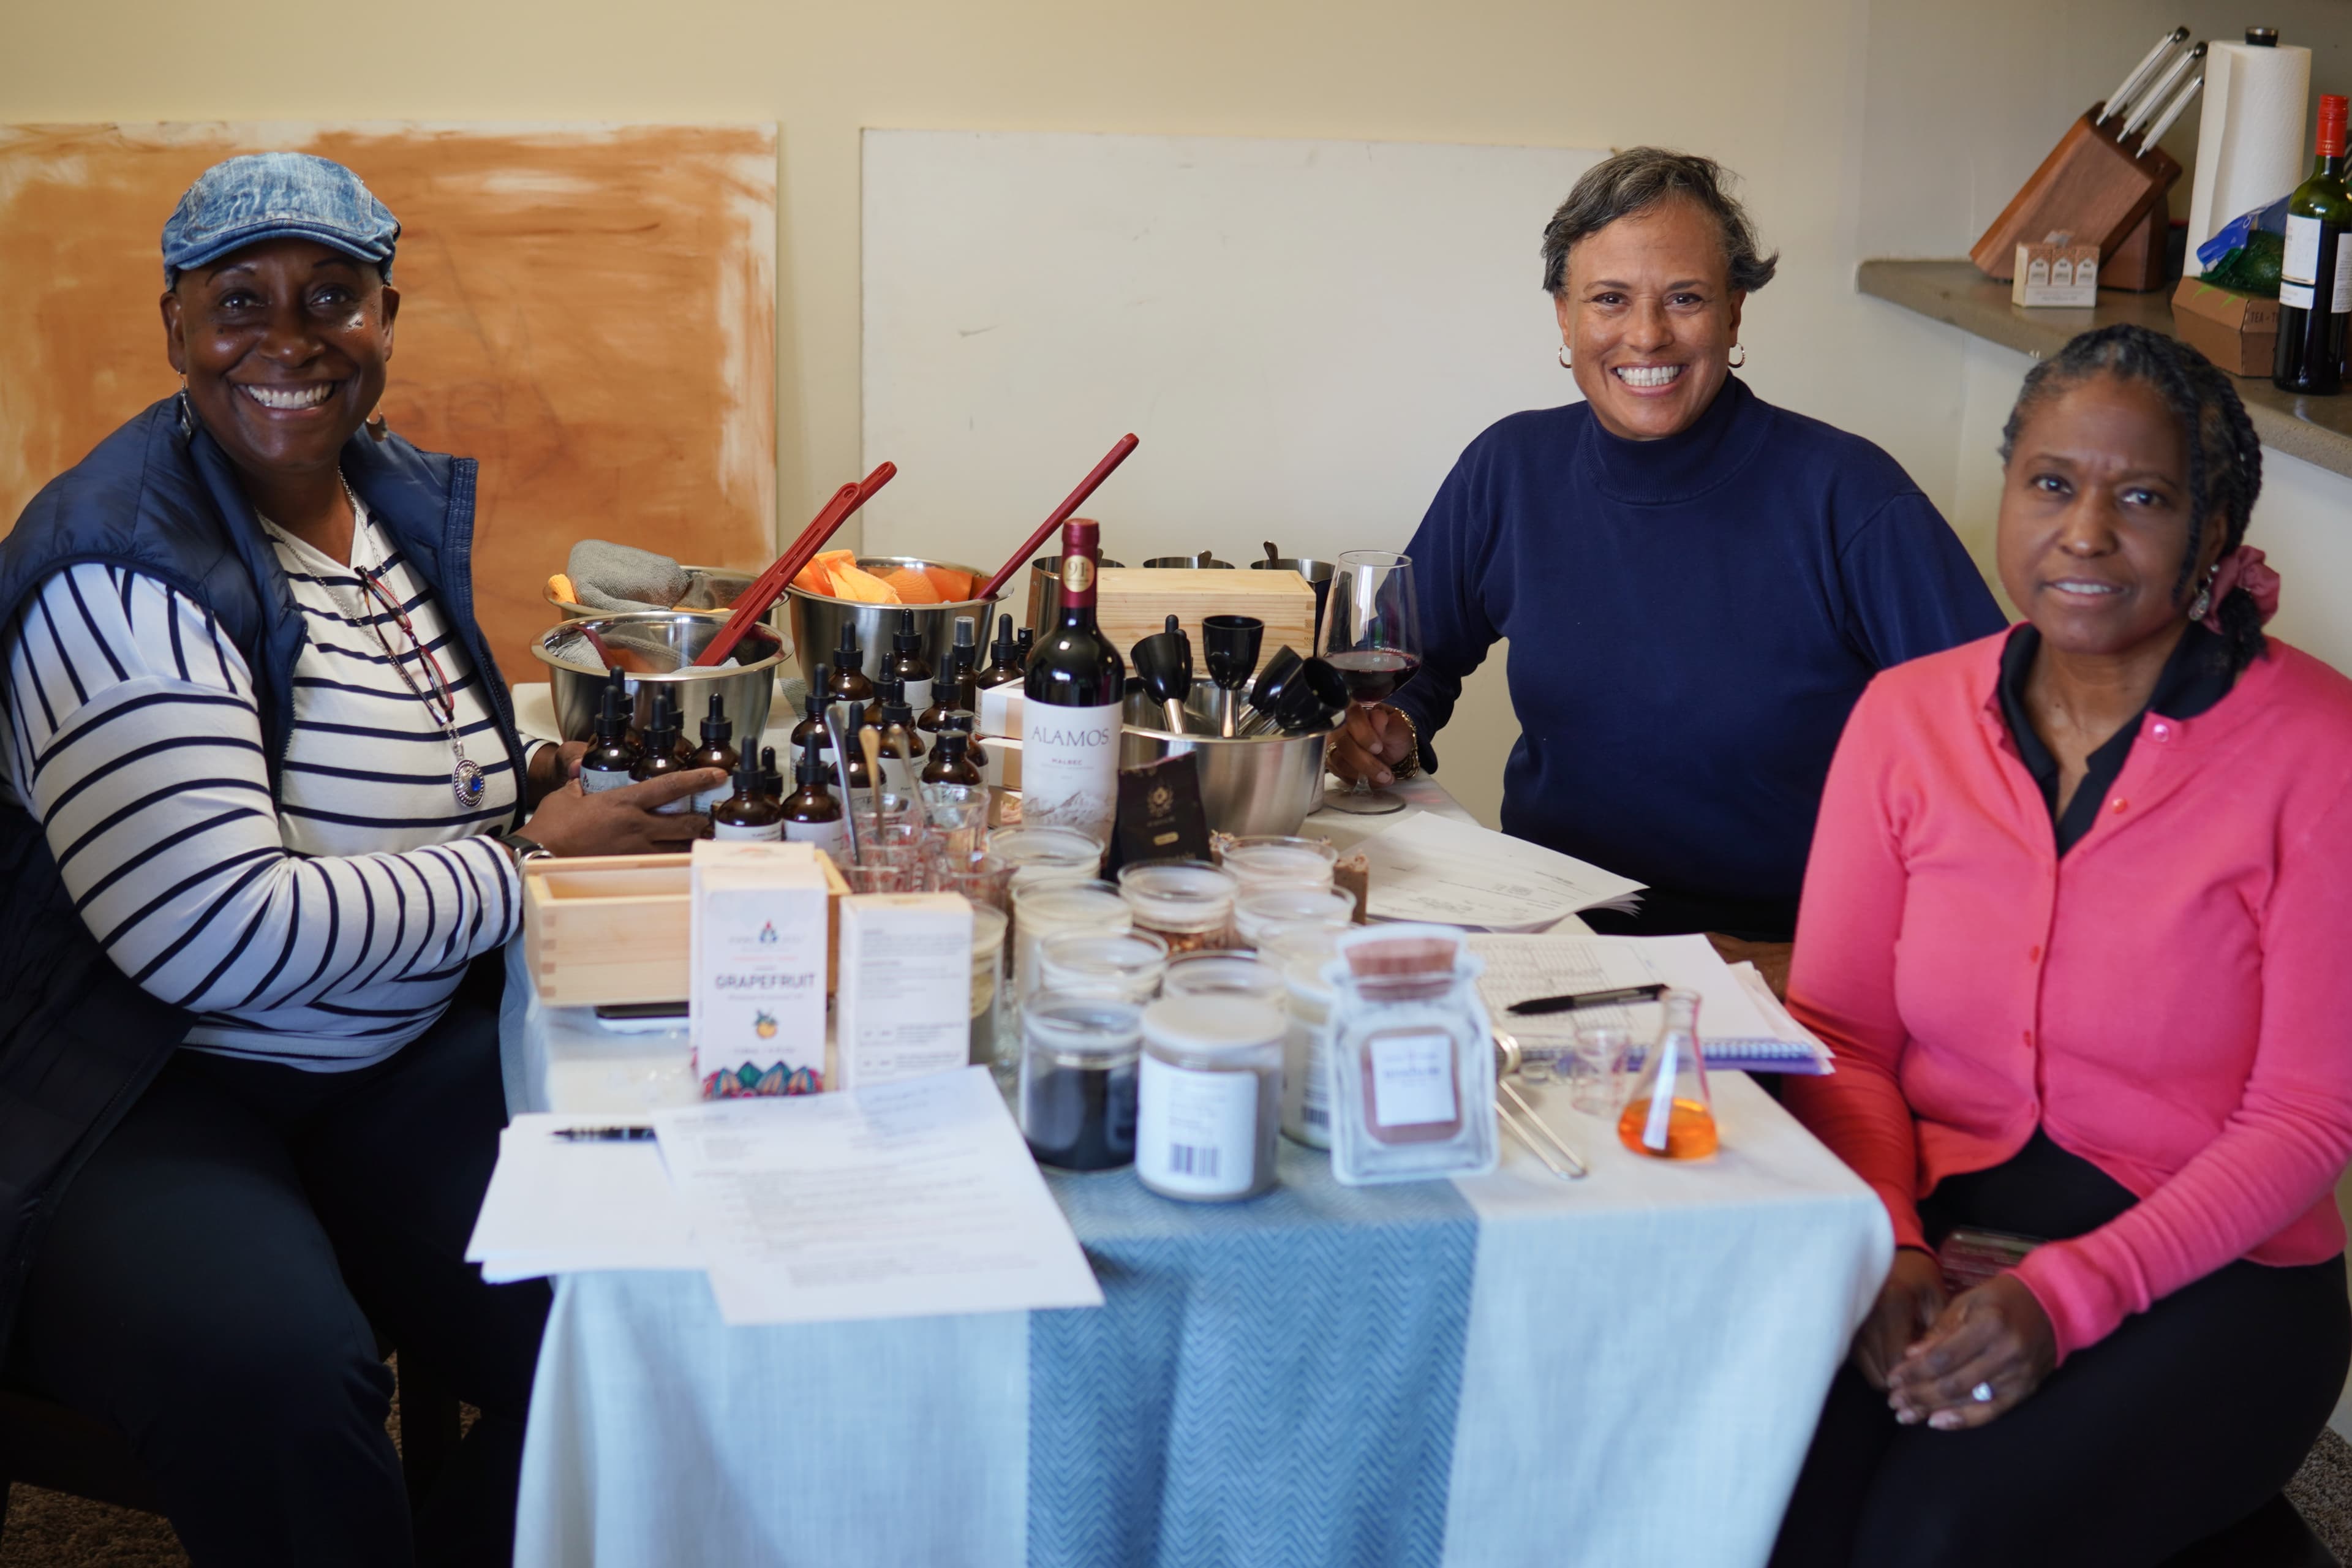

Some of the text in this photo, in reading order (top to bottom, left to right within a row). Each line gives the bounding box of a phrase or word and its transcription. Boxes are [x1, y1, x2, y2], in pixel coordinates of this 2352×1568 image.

[1031, 725, 1109, 747] ALAMOS
[1051, 757, 1083, 766] MALBEC
[715, 971, 815, 990] GRAPEFRUIT
